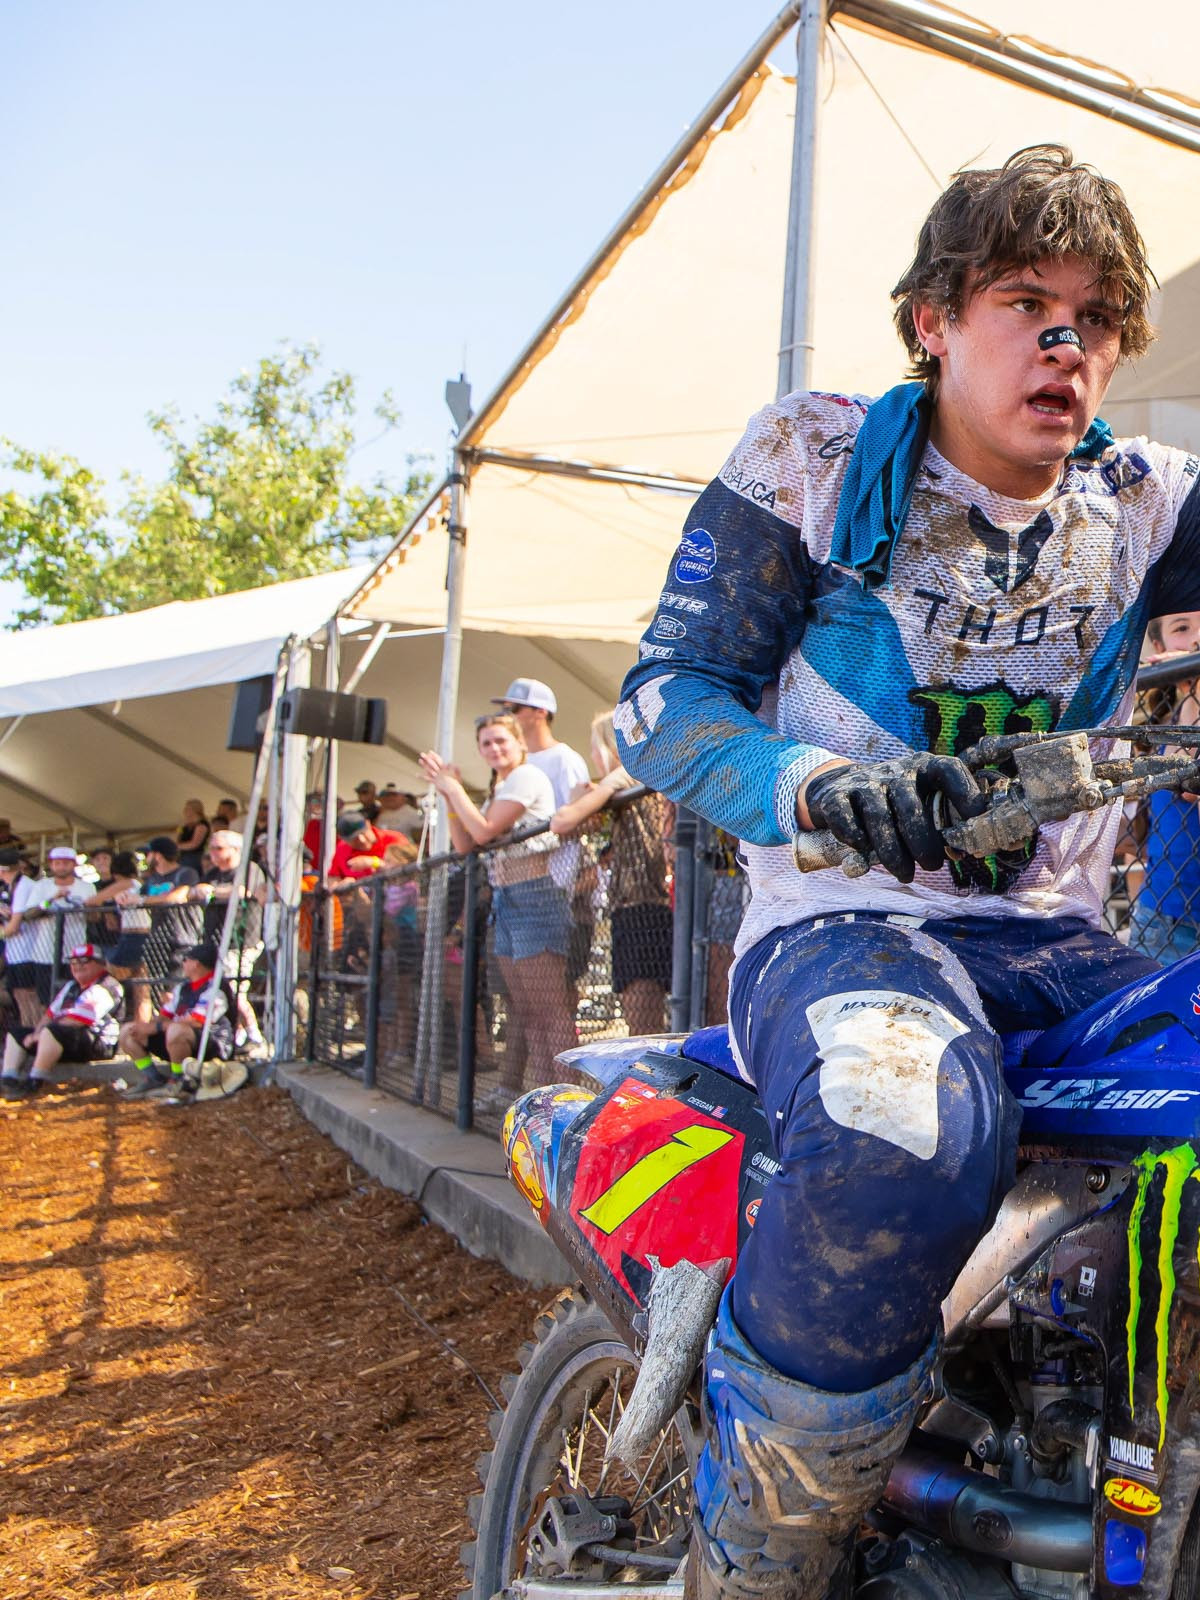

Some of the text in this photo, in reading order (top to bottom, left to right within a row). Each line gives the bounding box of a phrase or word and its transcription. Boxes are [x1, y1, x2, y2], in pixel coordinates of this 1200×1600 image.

[687, 1096, 714, 1112] DEEGAN
[578, 1123, 736, 1235] 1
[1109, 1435, 1155, 1471] YAMALUBE
[1104, 1480, 1161, 1510] FMF
